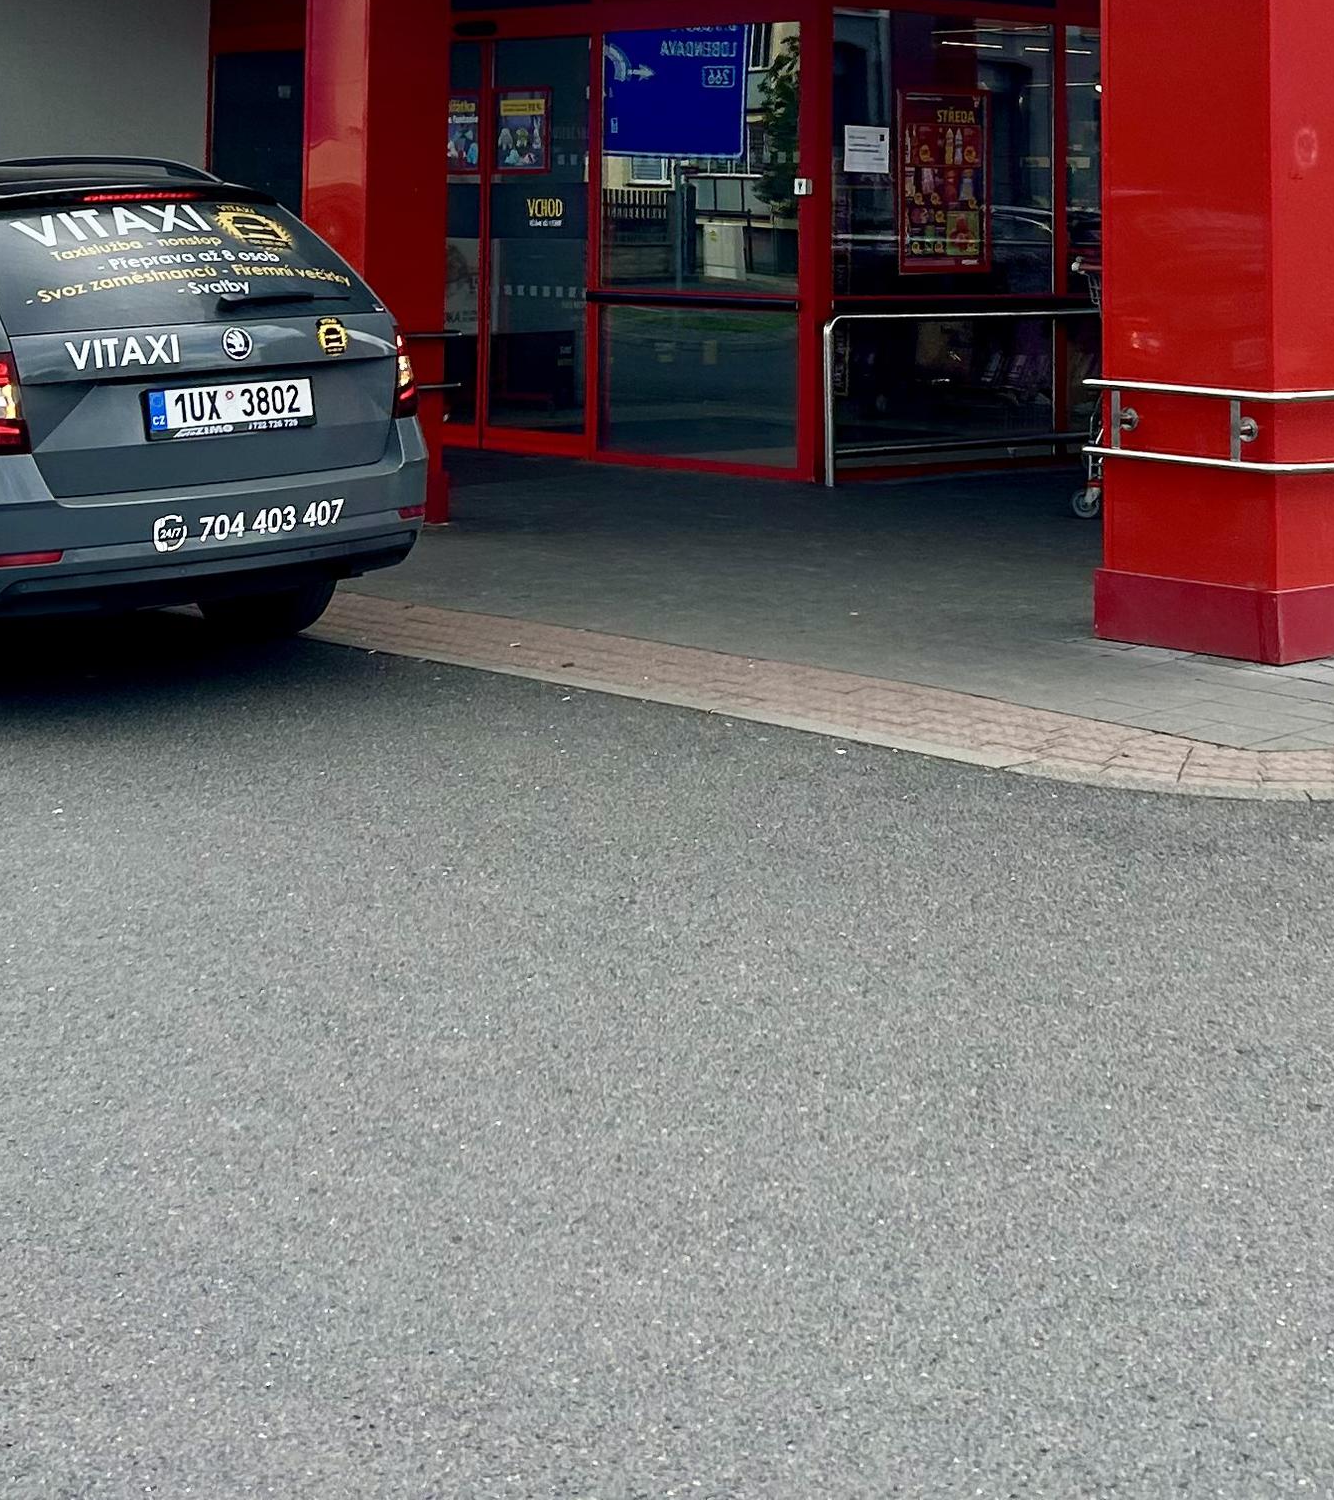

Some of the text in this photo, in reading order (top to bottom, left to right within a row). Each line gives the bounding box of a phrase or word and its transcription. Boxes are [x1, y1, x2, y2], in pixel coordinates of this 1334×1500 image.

[936, 106, 975, 124] STŘEDA
[527, 198, 564, 217] VCHOD
[9, 204, 213, 248] VITAXI
[50, 237, 144, 261] Taxislužba
[157, 235, 223, 249] nonstop
[108, 251, 196, 272] Přeprava
[198, 250, 219, 263] až
[221, 249, 236, 262] 8
[237, 251, 280, 263] osob
[37, 281, 88, 304] Svoz
[89, 264, 217, 292] zaměstnanců
[231, 264, 295, 277] Firemní
[296, 266, 352, 287] večírky
[187, 279, 251, 295] Svatby
[64, 332, 181, 371] VITAXI
[174, 384, 301, 423] 1UX 3802
[152, 415, 166, 426] CZ
[199, 498, 344, 542] 704 403 407
[159, 527, 182, 539] 24/7
